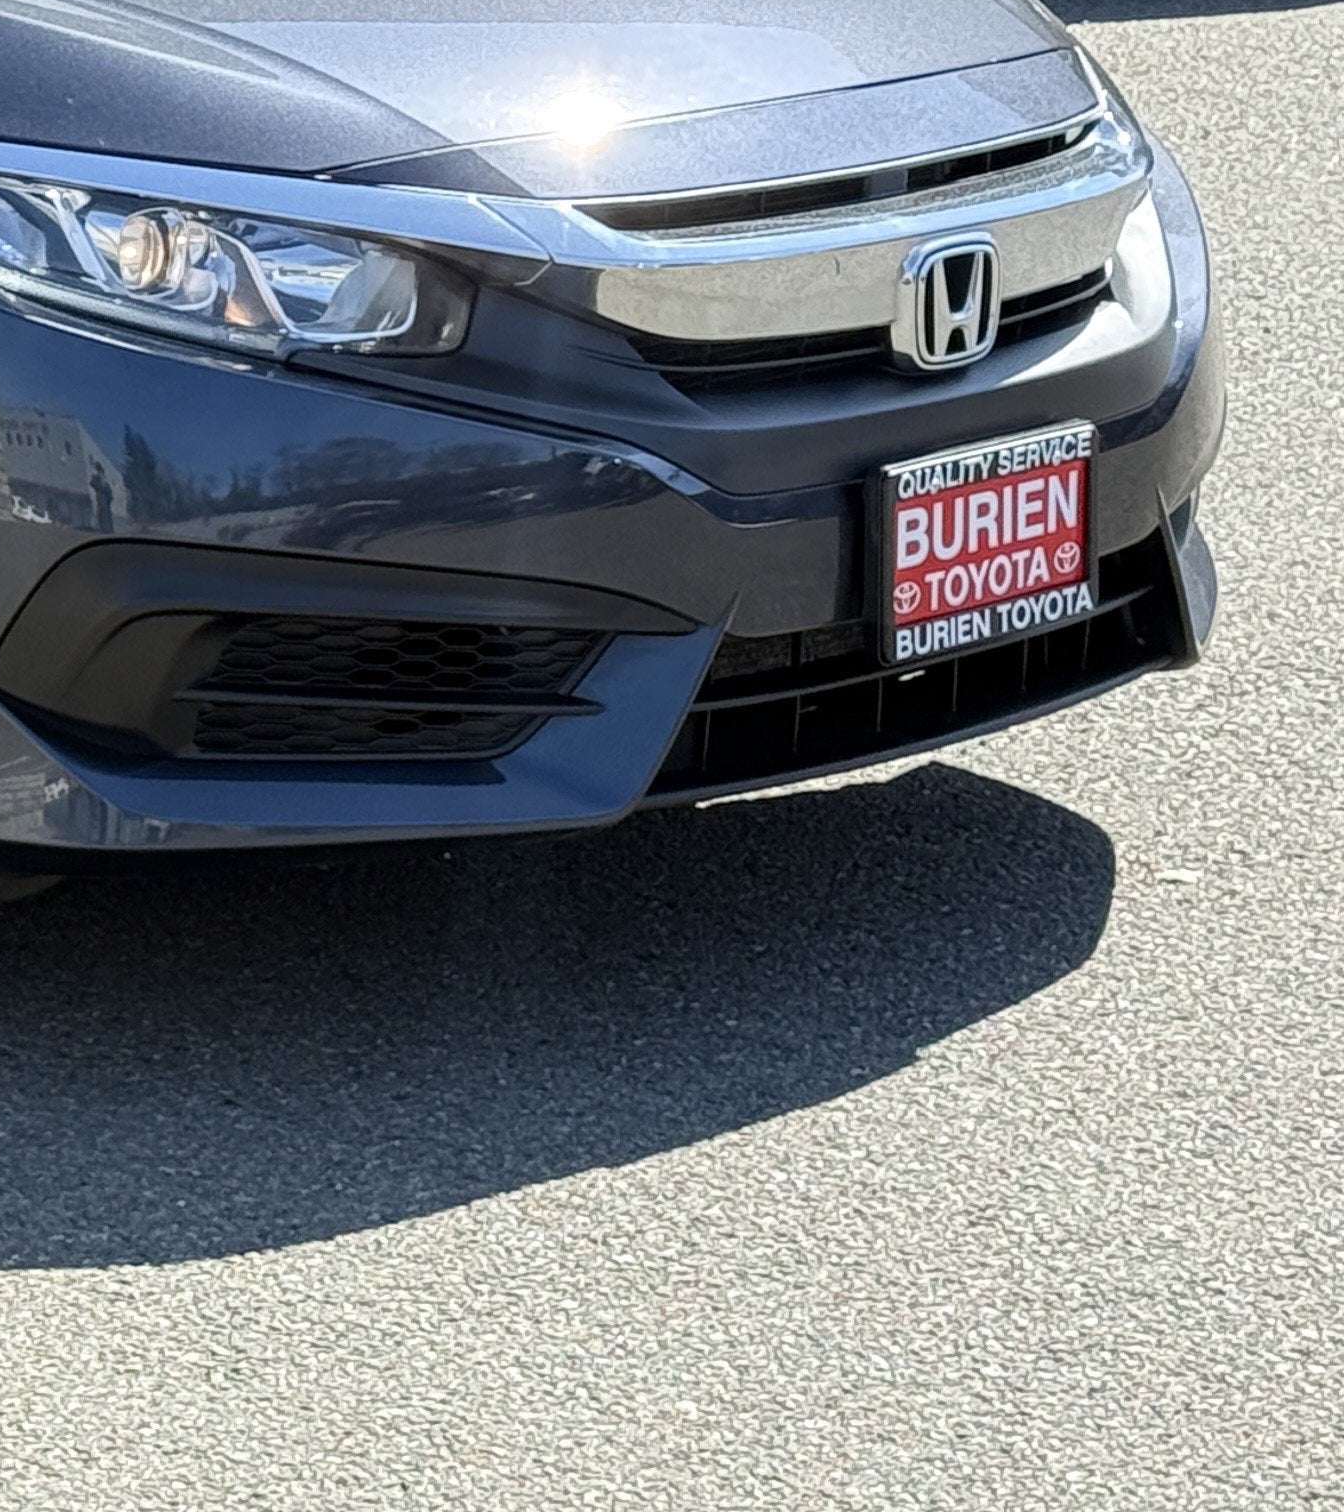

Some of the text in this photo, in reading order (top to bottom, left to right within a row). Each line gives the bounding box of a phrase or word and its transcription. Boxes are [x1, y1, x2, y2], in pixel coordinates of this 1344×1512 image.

[898, 430, 1092, 499] QUALITY SERVICE
[896, 469, 1079, 571] BURIEN
[925, 546, 1050, 611] TOYOTA
[896, 583, 1094, 661] BURIEN TOYOTA
